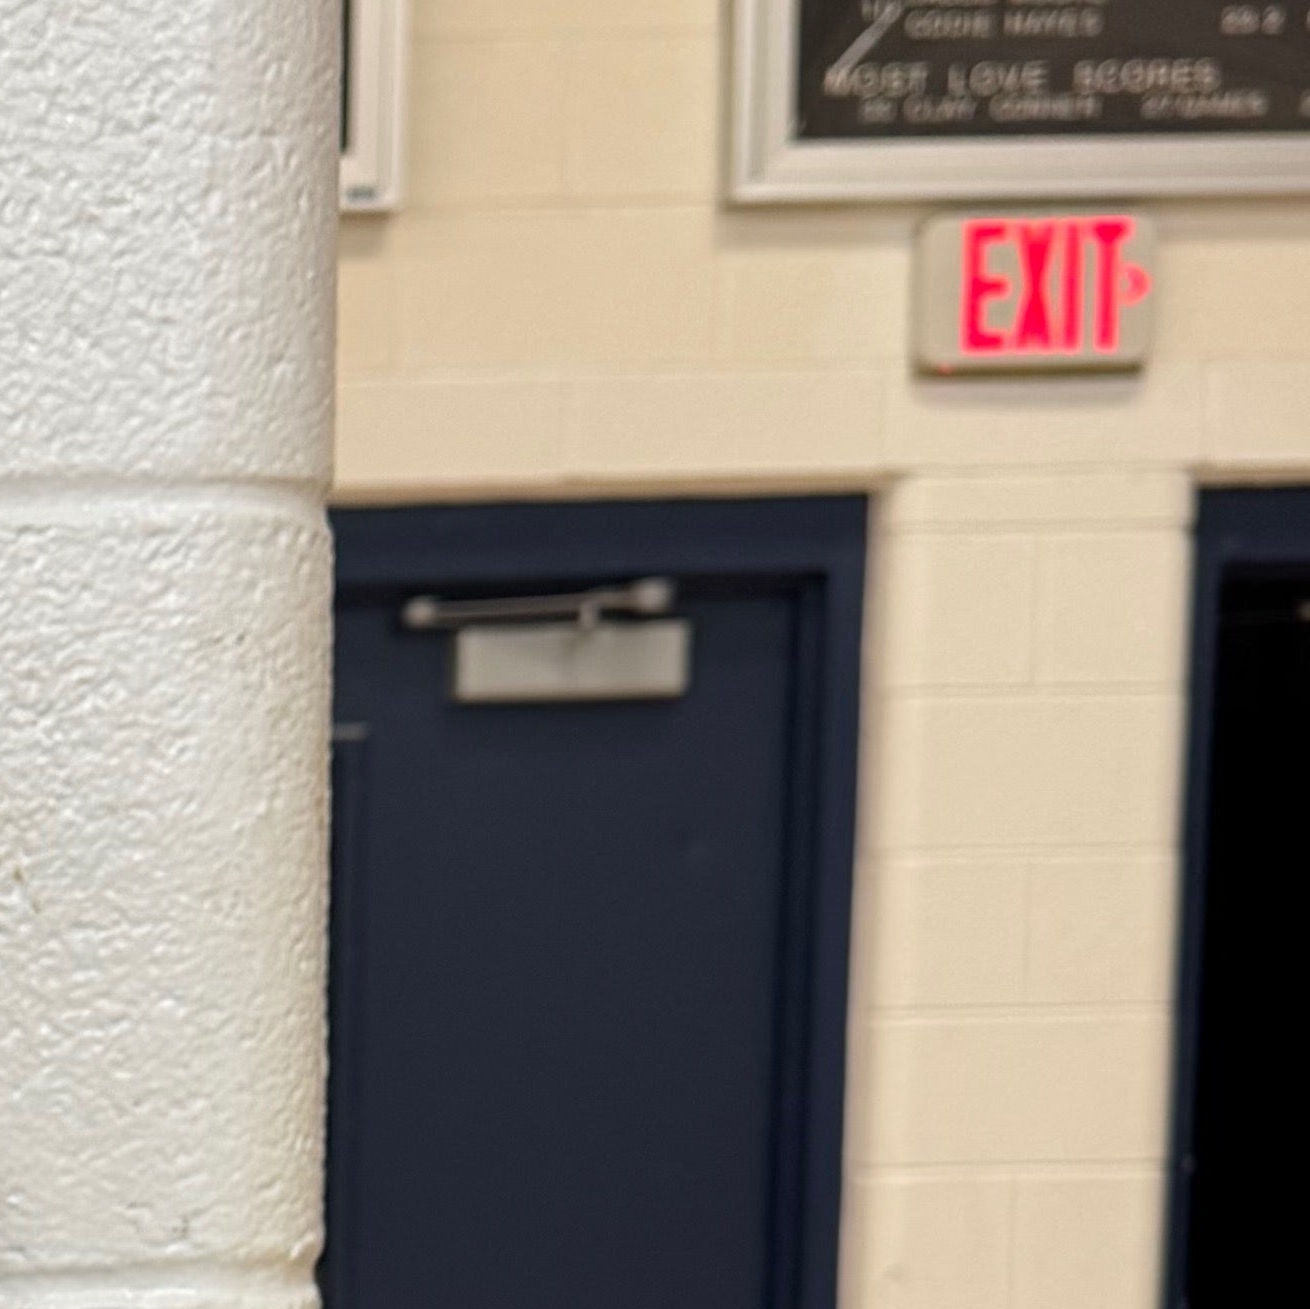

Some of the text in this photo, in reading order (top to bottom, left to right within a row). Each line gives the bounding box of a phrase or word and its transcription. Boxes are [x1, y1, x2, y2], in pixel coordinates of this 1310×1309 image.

[947, 60, 1050, 97] LOVE
[1073, 57, 1222, 94] SCORES
[959, 214, 1136, 356] EXIT
